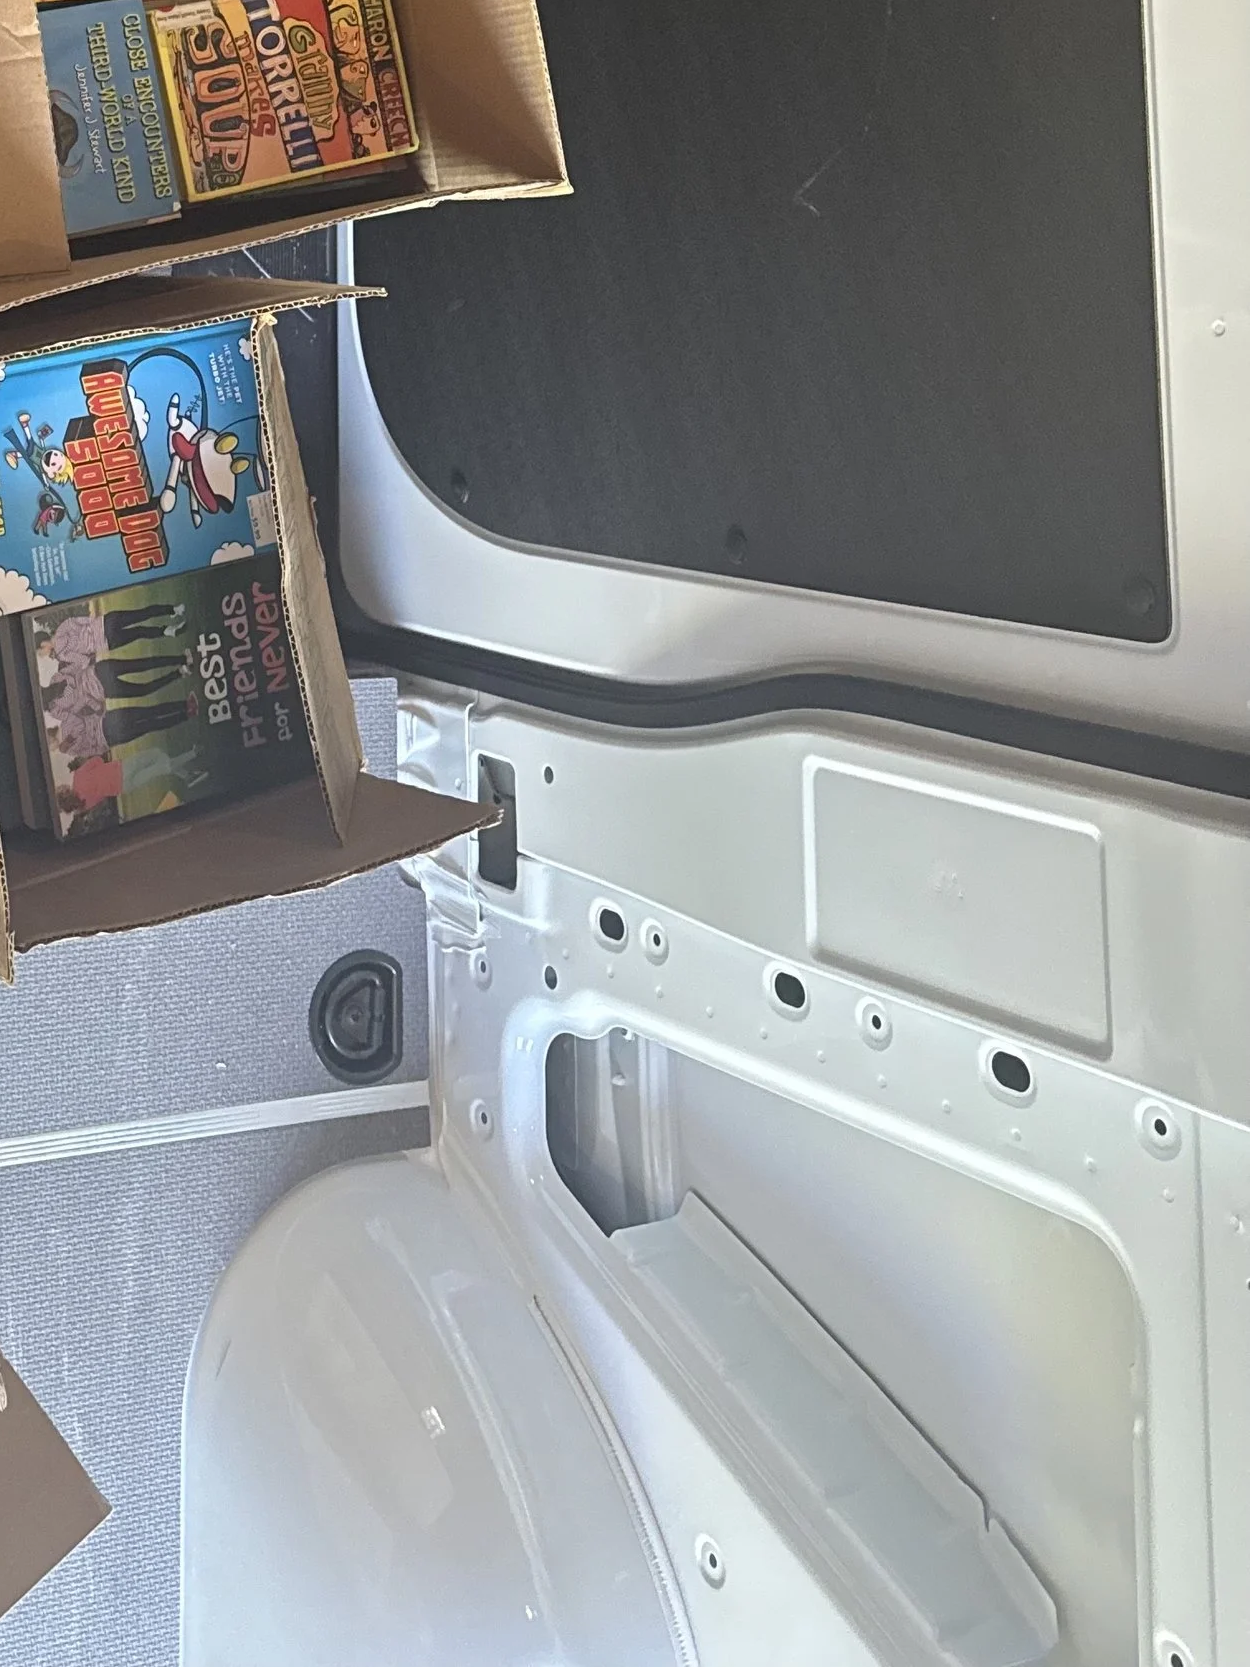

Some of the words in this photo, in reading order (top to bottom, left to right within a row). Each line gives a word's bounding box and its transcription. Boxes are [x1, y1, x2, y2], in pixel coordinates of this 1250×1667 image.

[122, 13, 148, 72] CLOSE
[234, 30, 277, 138] makes
[287, 25, 335, 132] Granny
[74, 63, 93, 115] Jennifer
[87, 128, 109, 174] Stewart
[86, 22, 126, 152] THIRD-WORLD
[111, 155, 136, 203] KIND
[121, 93, 134, 111] OF
[134, 74, 173, 199] ENCOUNTERS
[182, 23, 251, 186] SOUP
[376, 69, 411, 149] CREECH
[208, 352, 220, 384] TURBO
[217, 354, 228, 379] WITH
[62, 435, 120, 540] 5000
[81, 370, 150, 510] AWESOME
[117, 509, 167, 574] DOG
